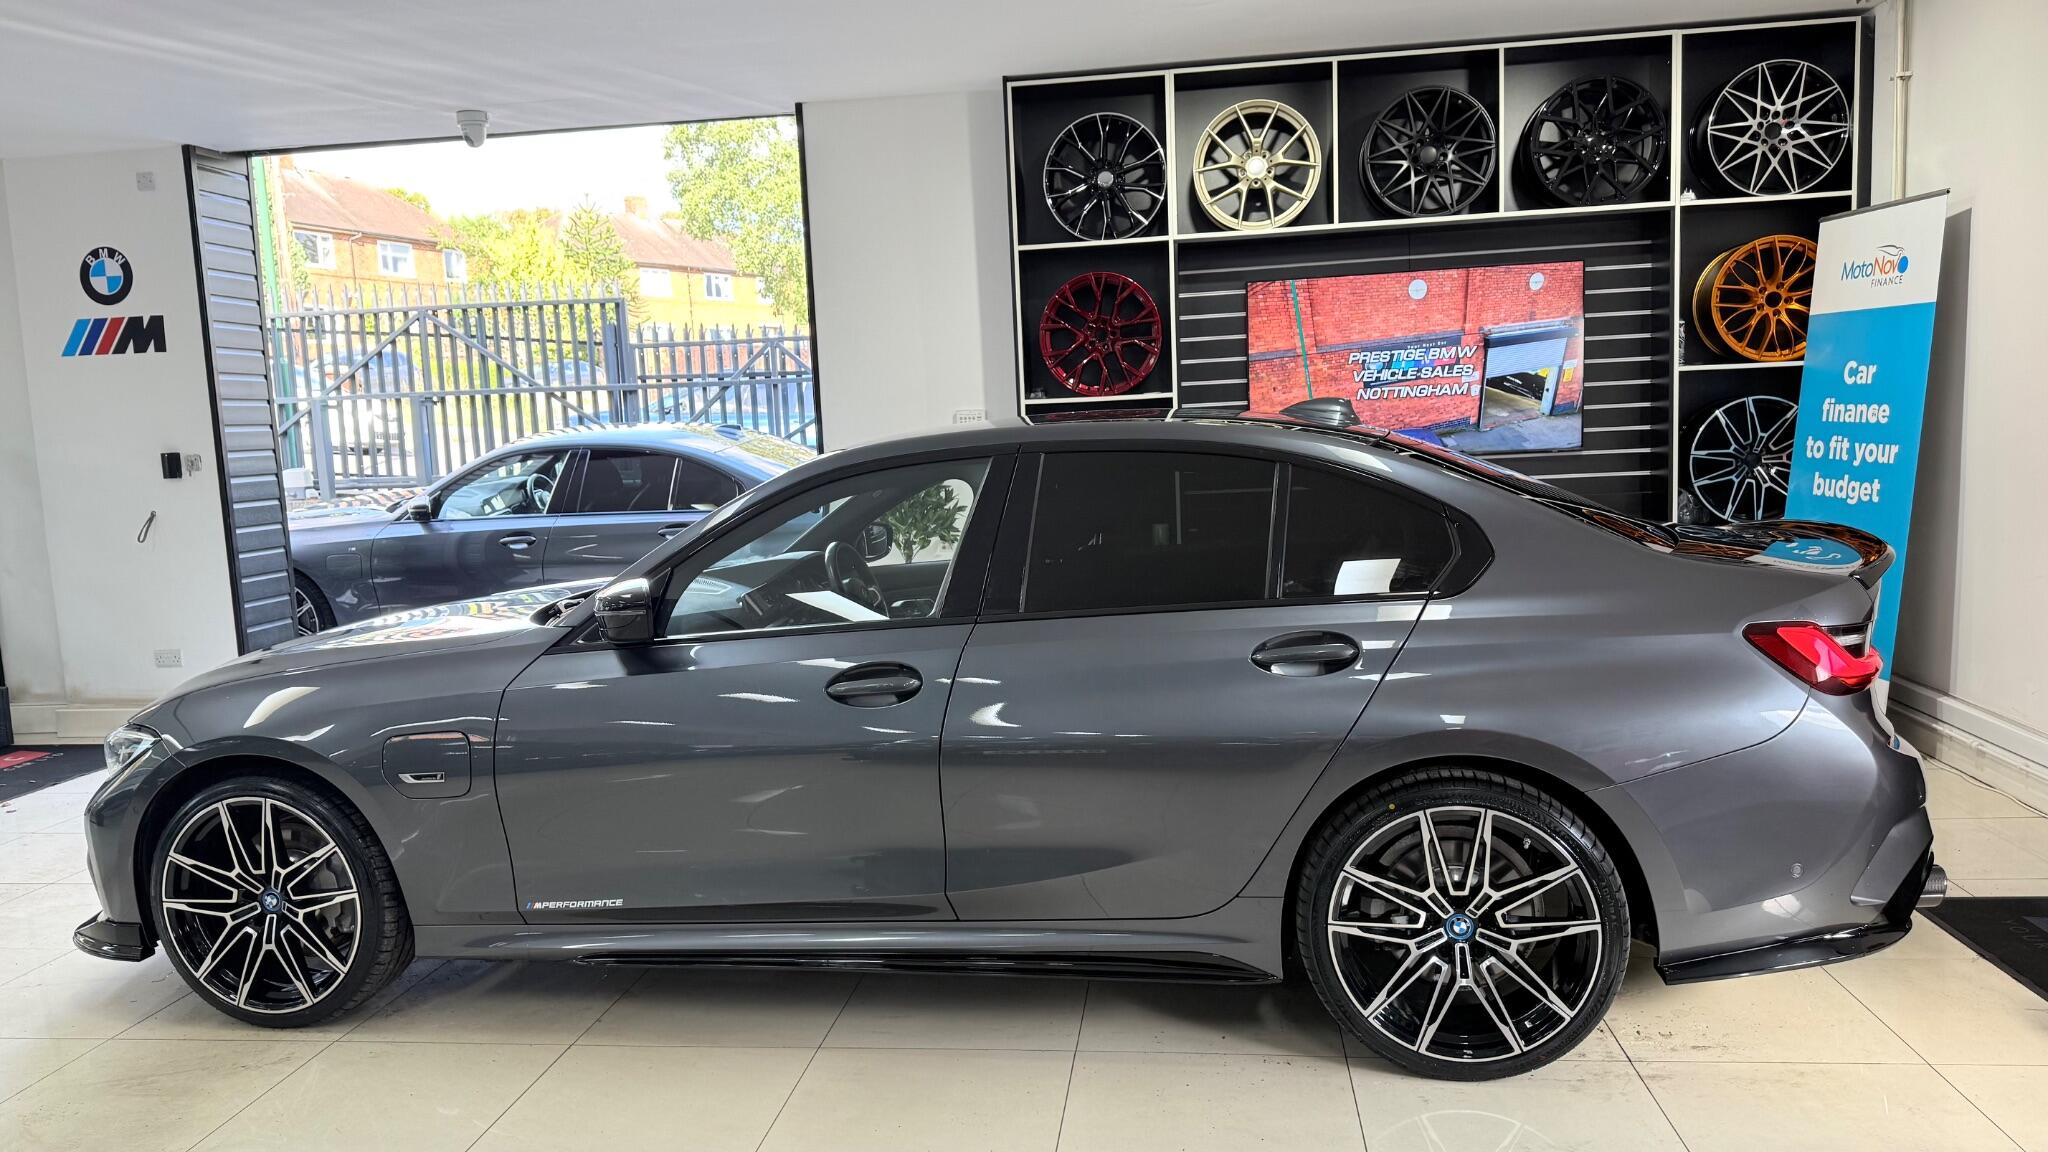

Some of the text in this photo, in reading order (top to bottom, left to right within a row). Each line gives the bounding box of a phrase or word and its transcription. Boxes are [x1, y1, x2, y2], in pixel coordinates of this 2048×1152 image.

[85, 248, 126, 265] BMW
[1871, 275, 1904, 288] FINANCE
[1348, 345, 1478, 364] PRESTIGE BMW
[1353, 364, 1474, 382] VEHICLE SALES
[1843, 360, 1877, 385] Car
[1356, 382, 1470, 400] NOTTINGHAM
[1822, 397, 1890, 423] finance
[1806, 435, 1900, 466] to fit your
[1812, 471, 1881, 504] budget
